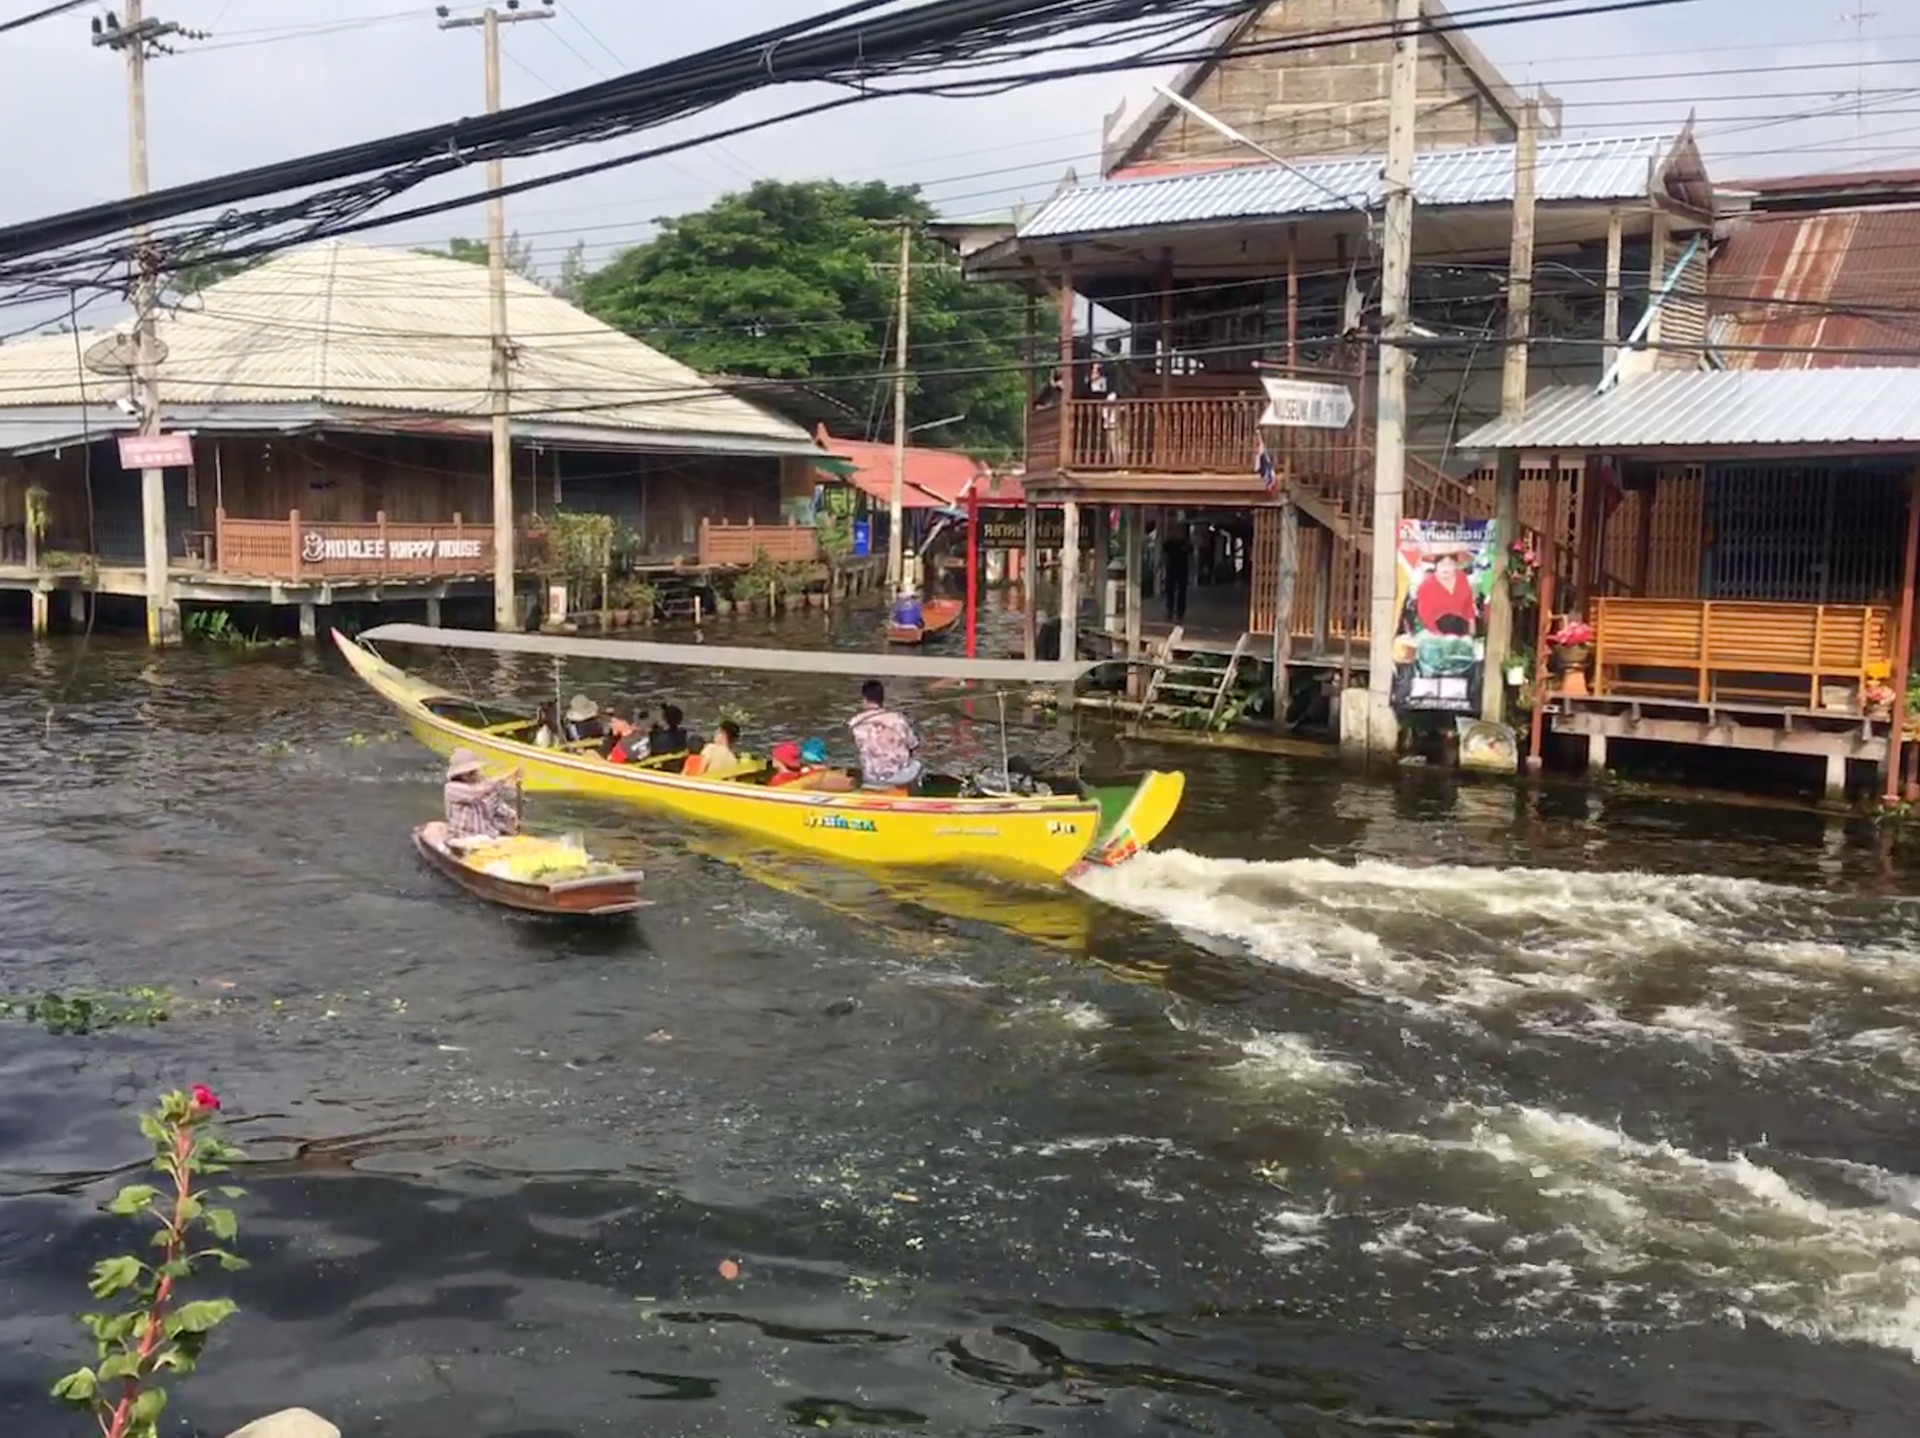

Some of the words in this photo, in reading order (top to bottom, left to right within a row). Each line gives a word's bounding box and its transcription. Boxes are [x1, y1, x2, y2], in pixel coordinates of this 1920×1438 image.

[1273, 398, 1309, 421] MUSEUM
[388, 540, 435, 559] HAPPY
[438, 539, 481, 558] HOUSE
